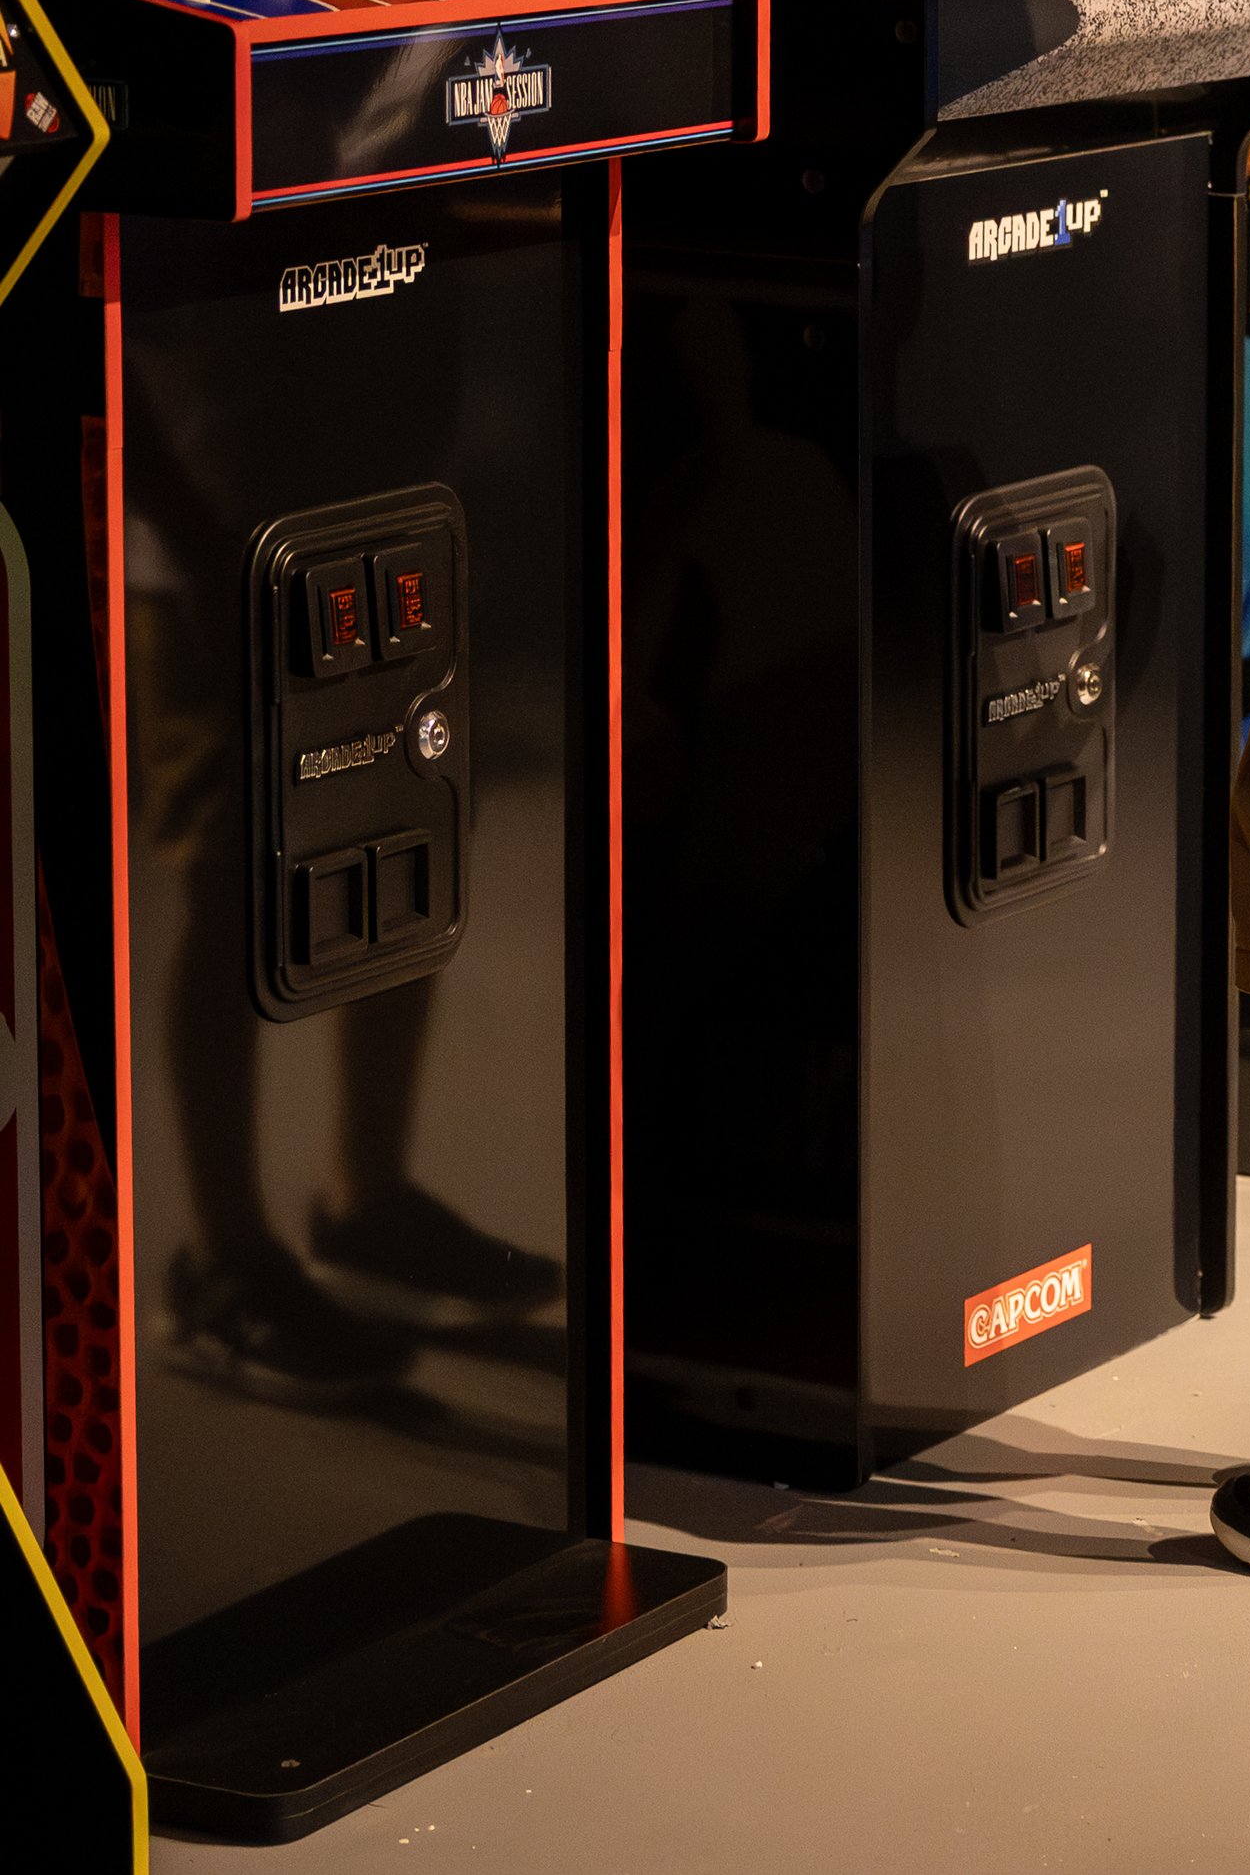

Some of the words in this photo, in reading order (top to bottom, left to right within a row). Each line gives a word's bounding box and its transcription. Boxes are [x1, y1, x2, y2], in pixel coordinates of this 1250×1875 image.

[454, 80, 473, 118] NBA
[474, 77, 493, 116] JAM
[506, 70, 544, 110] SESSION
[967, 198, 1101, 262] ARCADE1UP
[968, 1259, 1085, 1350] CAPCOM
